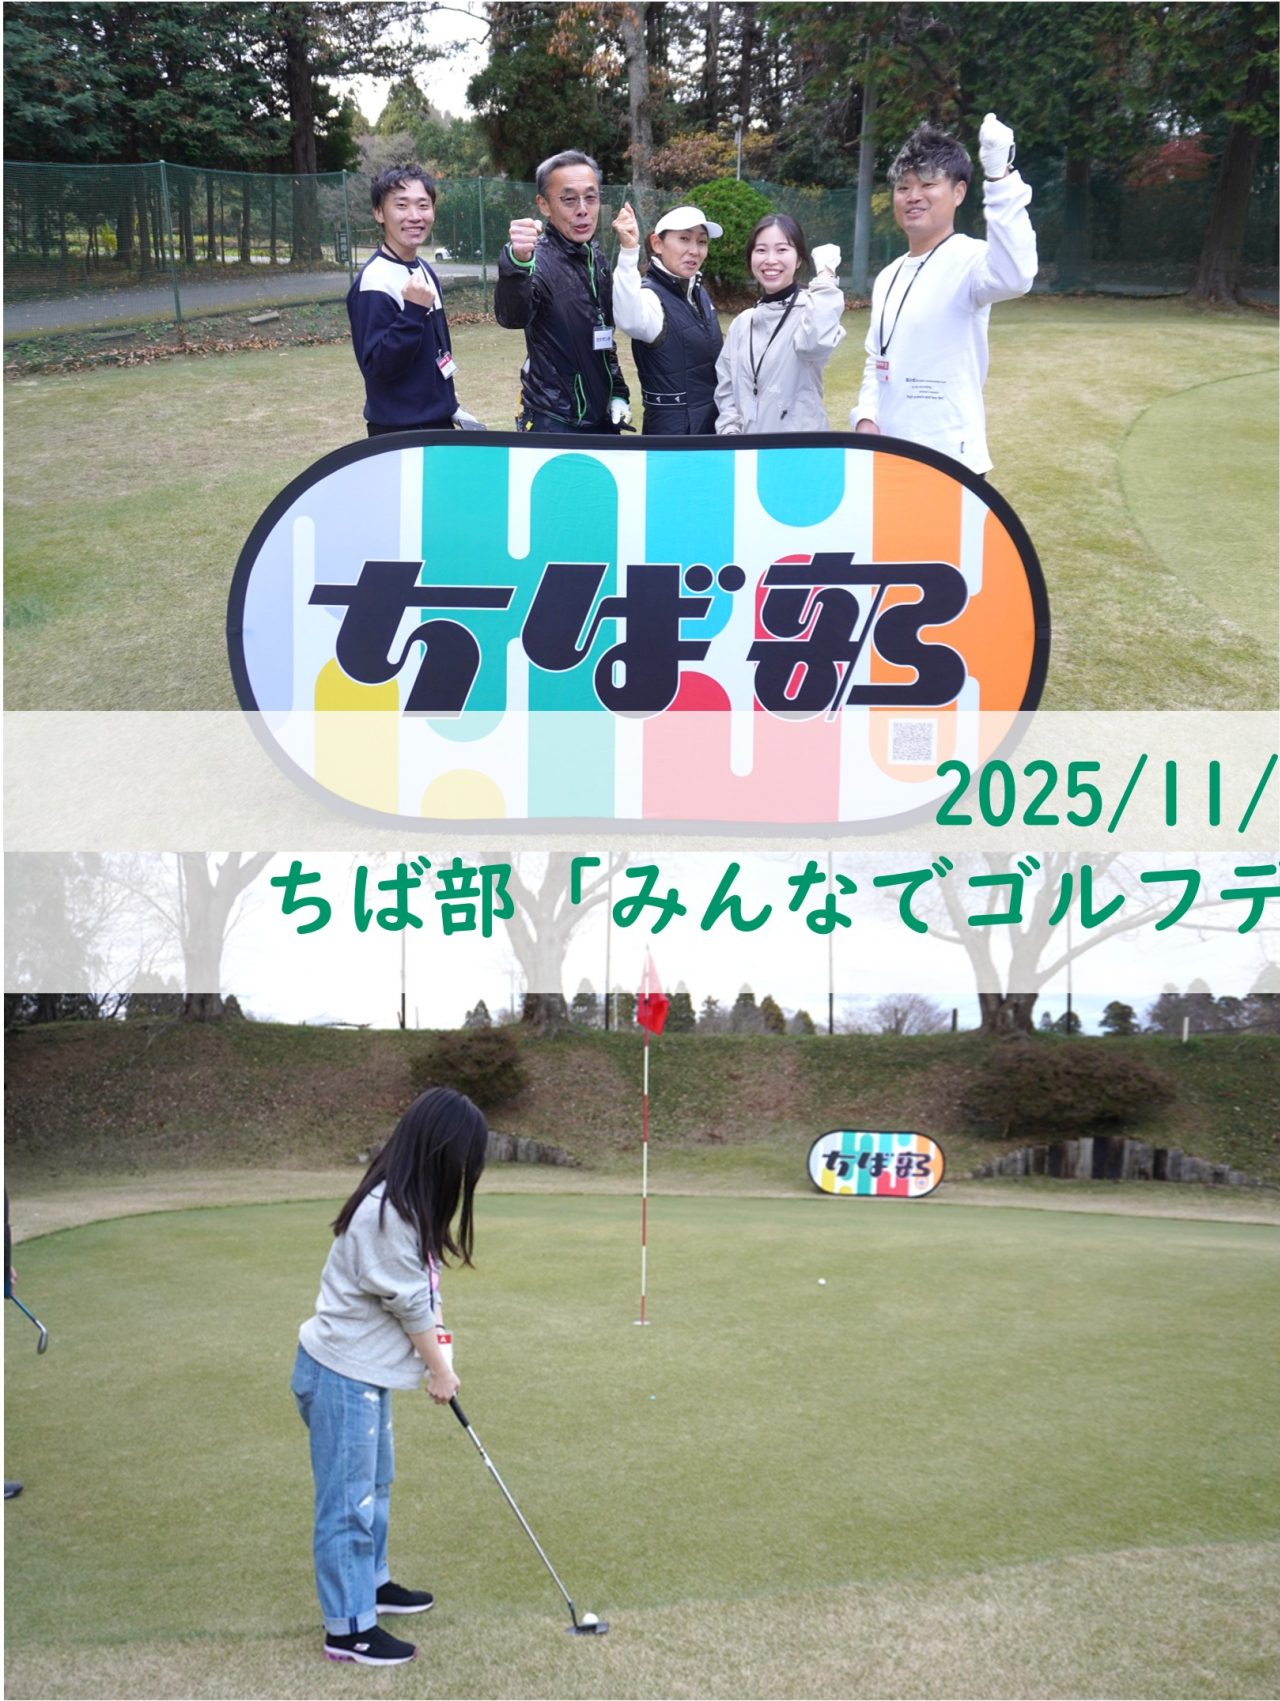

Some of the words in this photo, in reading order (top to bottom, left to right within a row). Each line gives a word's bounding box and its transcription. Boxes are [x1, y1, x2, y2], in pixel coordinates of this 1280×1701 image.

[308, 551, 968, 722] ちば部
[822, 1151, 931, 1178] ちば部
